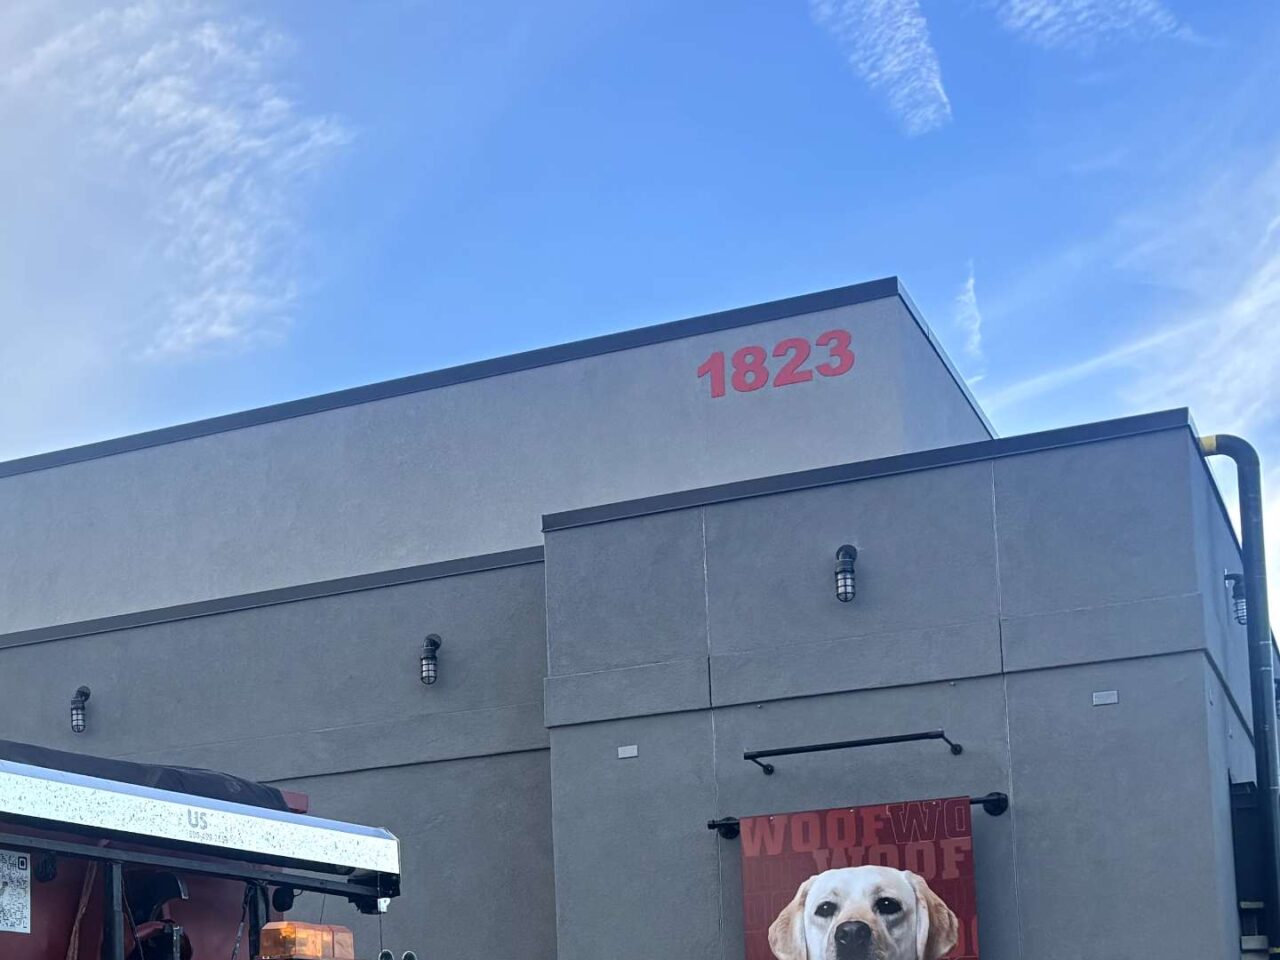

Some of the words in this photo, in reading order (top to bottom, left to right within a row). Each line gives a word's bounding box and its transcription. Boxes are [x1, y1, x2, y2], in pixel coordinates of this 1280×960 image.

[697, 329, 855, 399] 1823
[187, 809, 208, 830] US
[740, 806, 885, 856] WOOF
